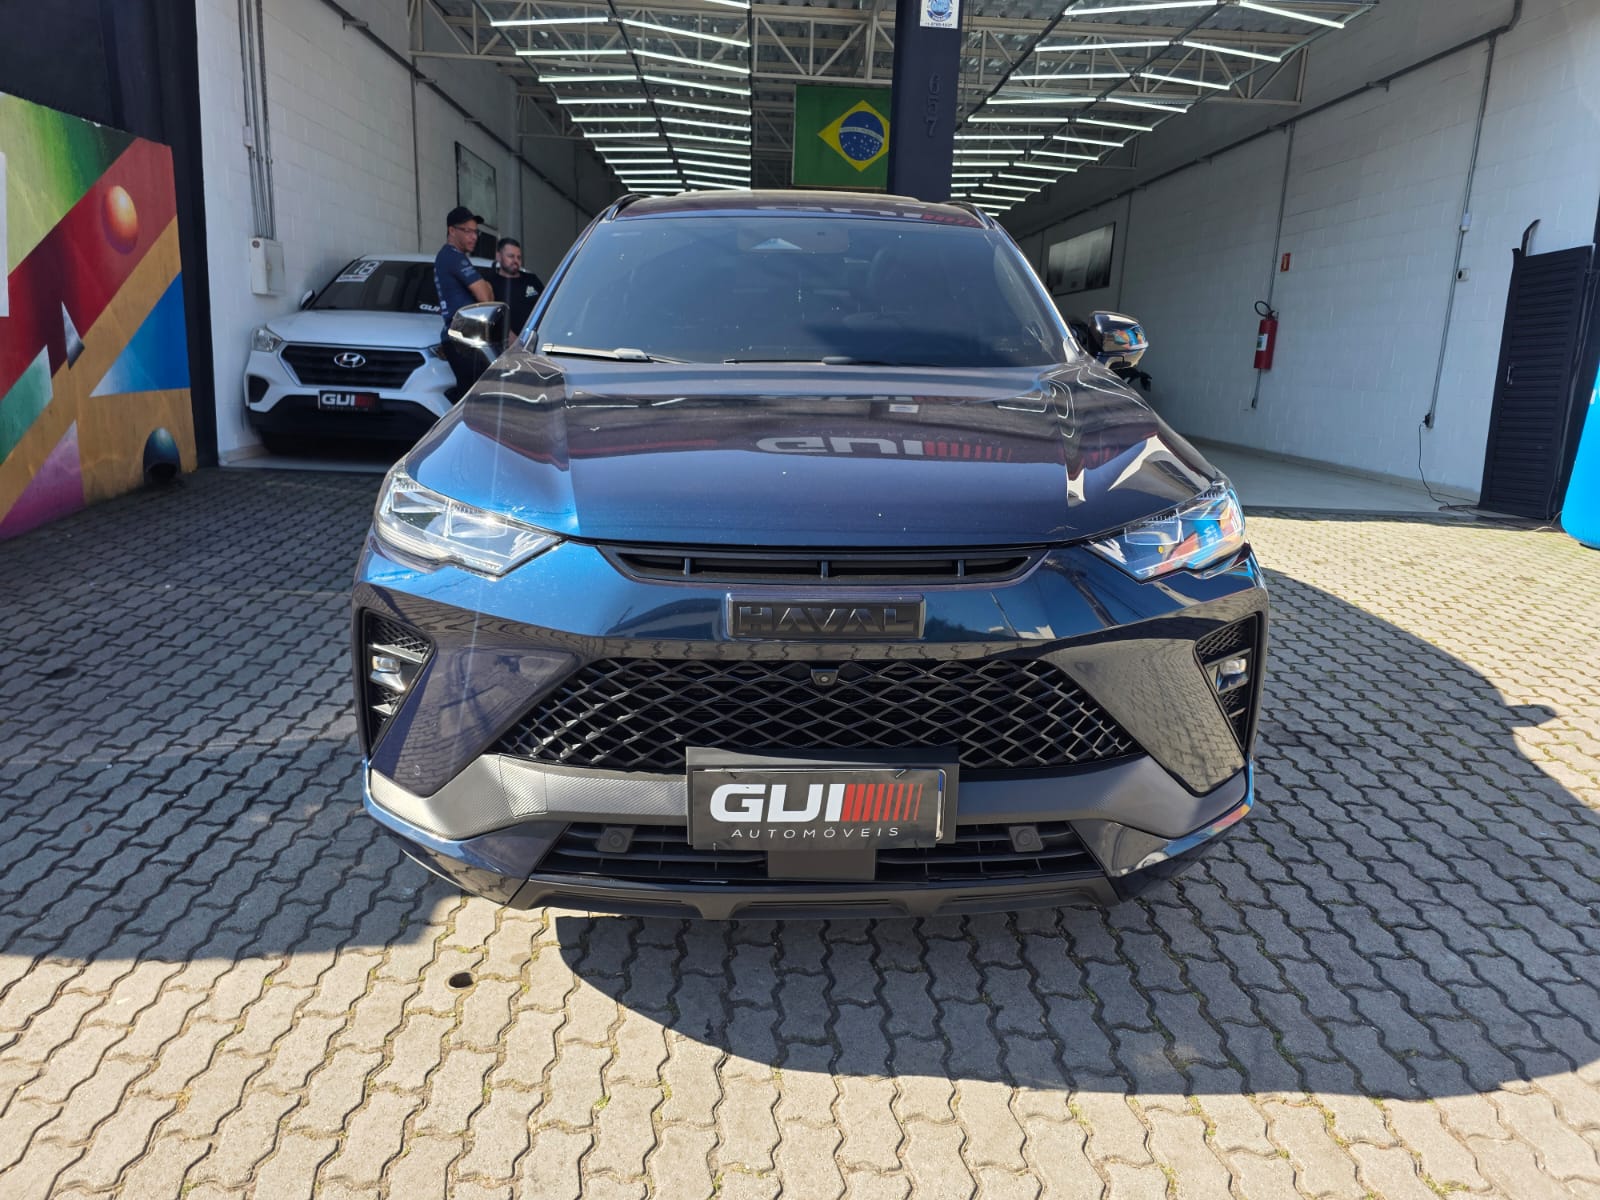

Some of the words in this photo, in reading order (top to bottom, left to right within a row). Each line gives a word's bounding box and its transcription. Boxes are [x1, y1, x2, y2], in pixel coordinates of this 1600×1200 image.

[321, 393, 355, 406] GUI
[738, 606, 914, 633] HAVAL
[709, 783, 846, 823] GUI
[731, 826, 901, 840] AUTOMÓVEIS
